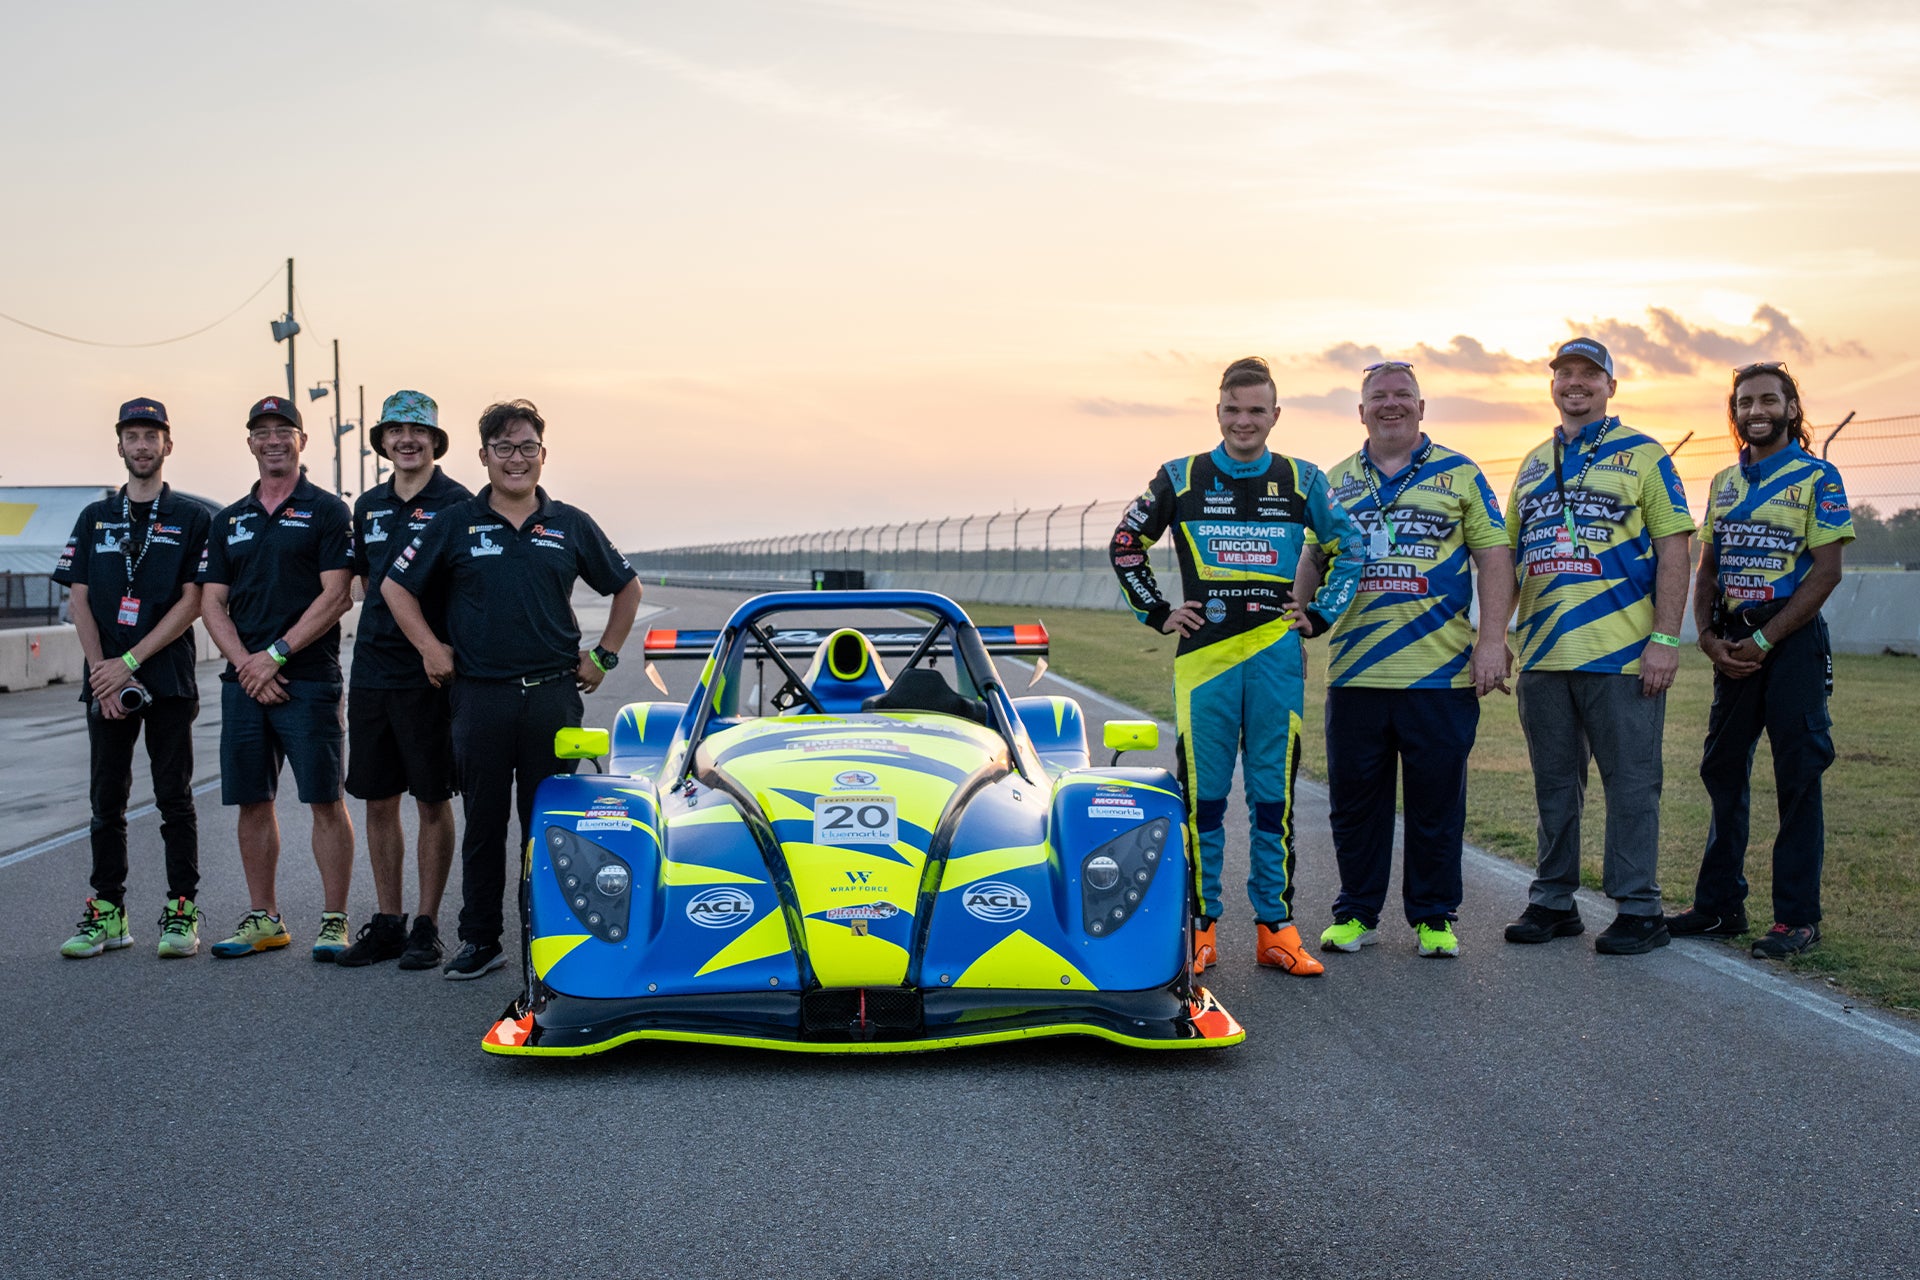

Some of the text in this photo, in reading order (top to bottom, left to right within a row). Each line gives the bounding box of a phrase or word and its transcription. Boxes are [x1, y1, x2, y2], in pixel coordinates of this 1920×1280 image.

[1203, 506, 1237, 515] HAGERTY
[1349, 509, 1444, 523] ACING WITH
[1198, 525, 1286, 537] SPARKPOWER
[1713, 520, 1790, 537] RACING WITH
[1211, 540, 1267, 552] LINCOLN
[1720, 532, 1798, 551] AUTISM
[1223, 553, 1272, 563] WELDERS
[1525, 547, 1586, 564] LINCN
[1361, 565, 1412, 578] COLN
[1533, 561, 1593, 574] WELDERS
[1358, 579, 1419, 592] WELDERS
[1208, 588, 1278, 598] RADICAL
[1094, 798, 1135, 806] MOTUL
[822, 805, 890, 830] 20
[690, 901, 751, 914] ACL
[966, 894, 1028, 908] ACL
